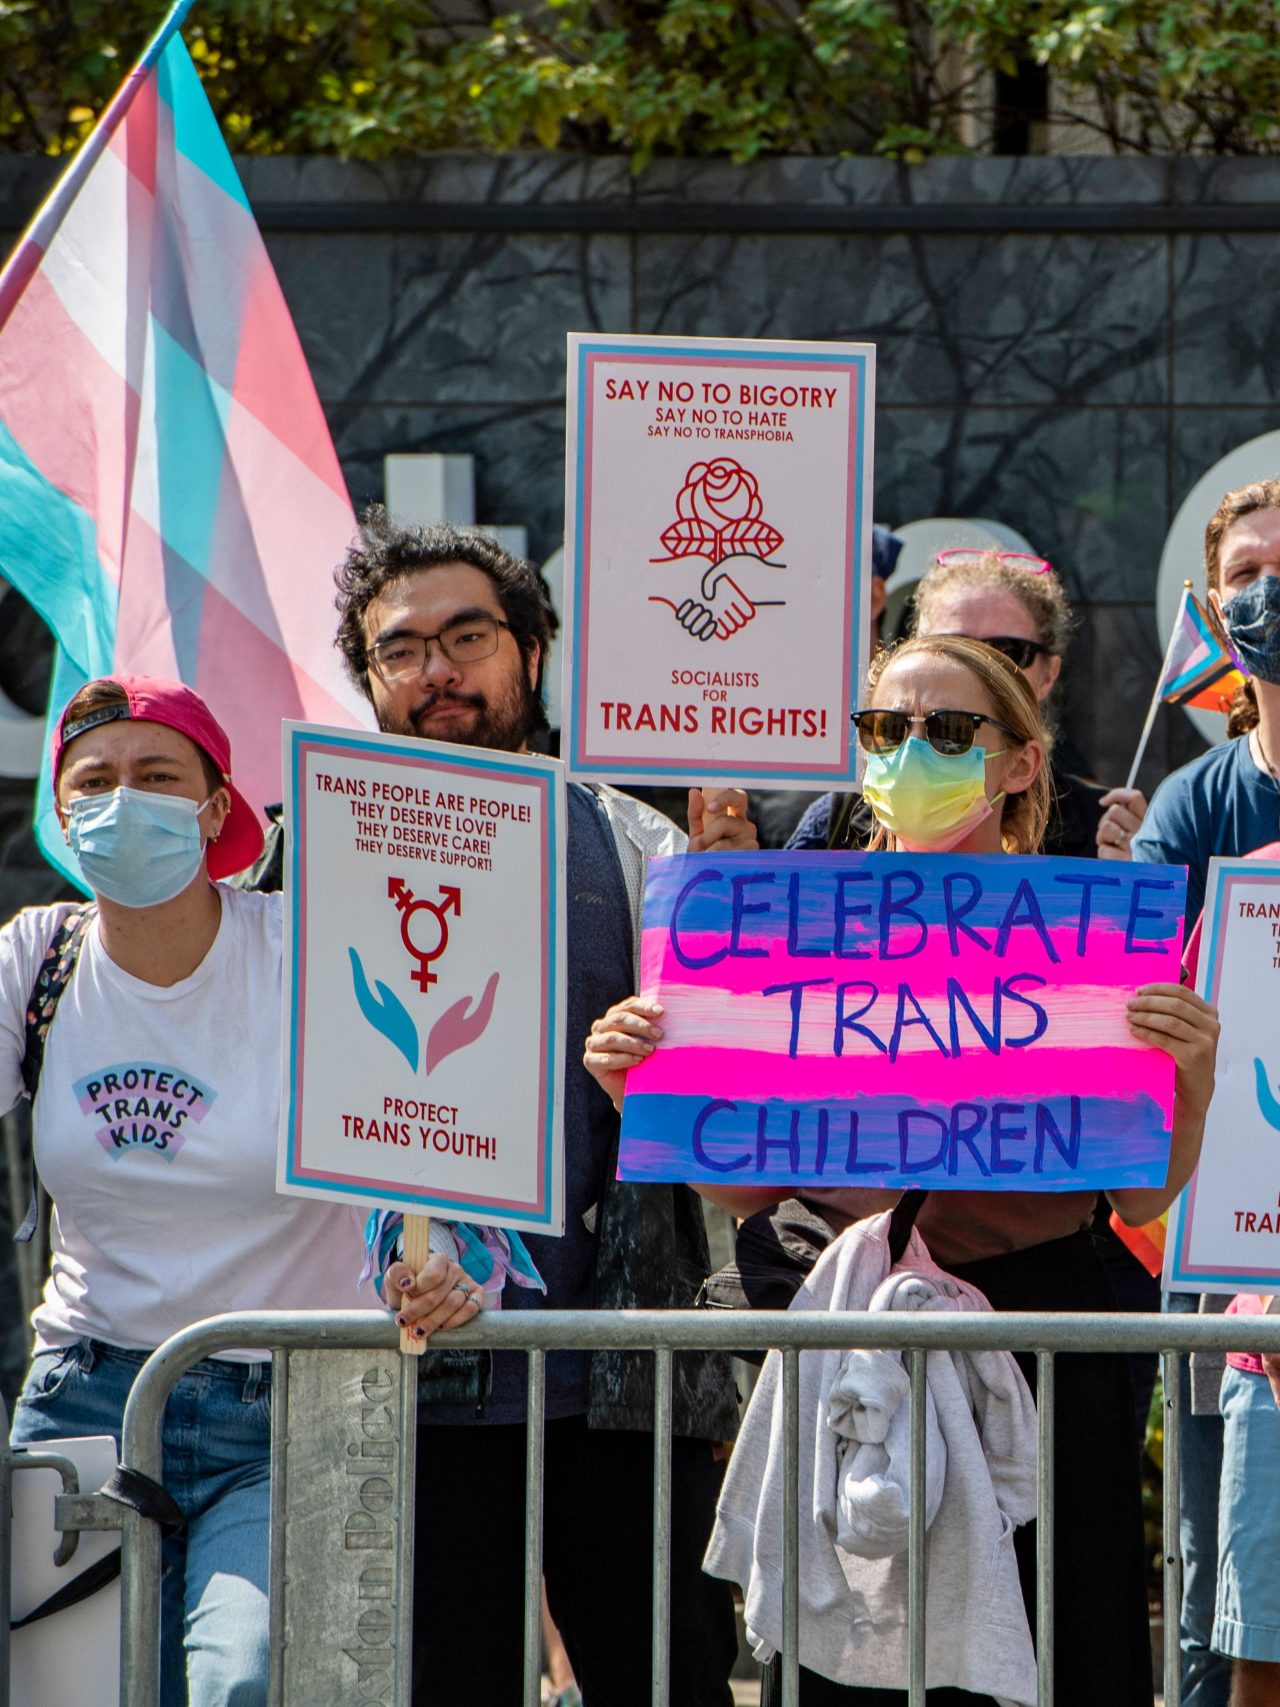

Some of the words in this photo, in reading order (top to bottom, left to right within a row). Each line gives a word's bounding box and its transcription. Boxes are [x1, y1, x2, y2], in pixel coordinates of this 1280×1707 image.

[605, 379, 649, 400] SAY
[658, 381, 694, 403] NO
[702, 383, 731, 404] TO
[740, 385, 837, 408] BIGOTRY
[648, 426, 668, 437] SAY
[674, 427, 692, 438] NO
[696, 428, 710, 439] TO
[714, 428, 794, 442] TRANSPHOBIA
[655, 407, 686, 423] SAY
[692, 409, 717, 424] NO
[722, 410, 742, 425] TO
[748, 412, 787, 427] HATE
[671, 670, 759, 688] SOCIALISTS
[703, 689, 727, 702] FOR
[601, 702, 698, 733] TRANS
[711, 706, 827, 738] RIGHTS!
[316, 773, 367, 798] TRANS
[372, 782, 430, 806] PEOPLE
[435, 792, 464, 812] ARE
[470, 797, 531, 823] PEOPLE!
[350, 800, 385, 819] THEY
[391, 806, 451, 830] DESERVE
[456, 816, 497, 838] LOVE!
[355, 838, 383, 854] THEY
[388, 843, 436, 862] DESERVE
[440, 851, 492, 871] SUPPORT!
[357, 821, 388, 838] THEY
[393, 827, 448, 848] DESERVE
[452, 836, 491, 855] CARE!
[669, 869, 1177, 970] CELEBRATE
[762, 973, 1048, 1063] TRANS
[86, 1069, 203, 1106] PROTECT
[95, 1096, 188, 1128] TRANS
[384, 1097, 458, 1125] PROTECT
[110, 1123, 174, 1149] KIDS
[342, 1114, 411, 1146] TRANS
[419, 1126, 497, 1160] YOUTH!
[692, 1095, 1081, 1179] CHILDREN
[345, 1367, 396, 1551] Police
[342, 1567, 395, 1707] ston
